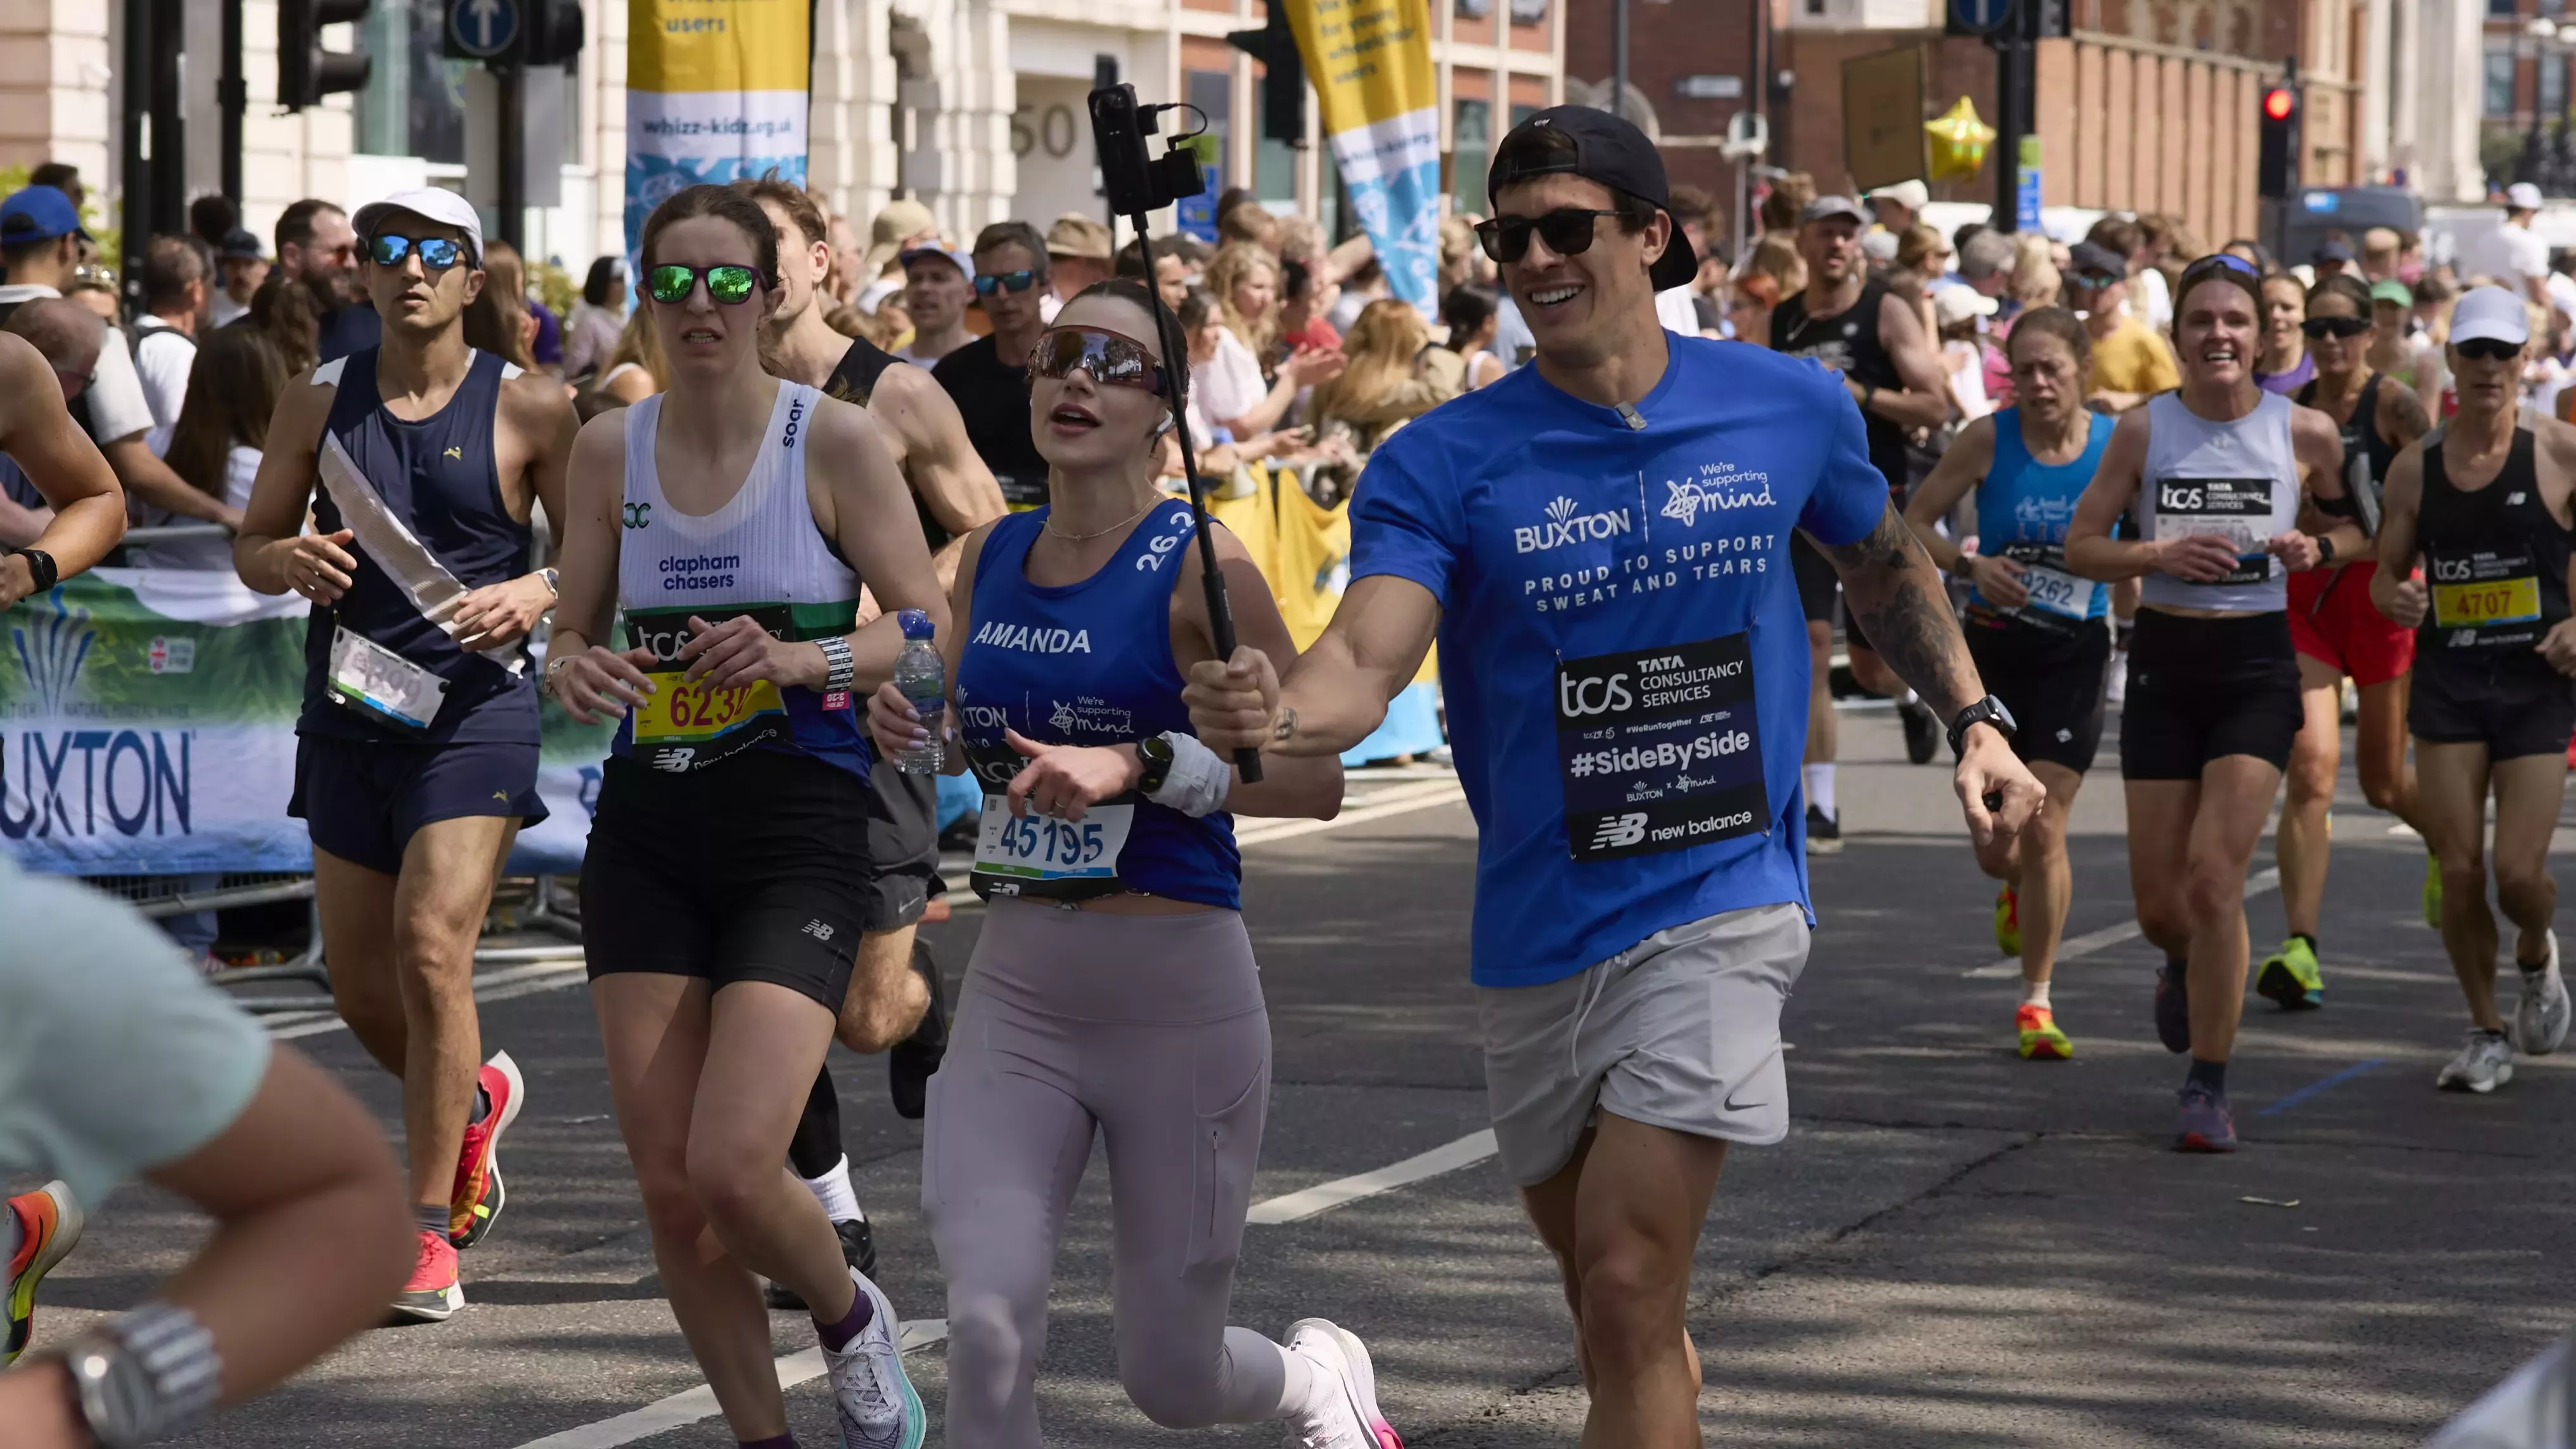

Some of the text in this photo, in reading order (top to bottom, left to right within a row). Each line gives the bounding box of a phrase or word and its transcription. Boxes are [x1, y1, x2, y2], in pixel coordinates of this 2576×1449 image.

[665, 17, 726, 32] users
[783, 399, 804, 449] soar
[1700, 461, 1735, 476] We're
[1701, 471, 1768, 487] supporting
[1701, 484, 1777, 513] mind
[2162, 483, 2204, 509] tcs
[1136, 511, 1195, 571] 26.2
[1514, 507, 1631, 554] BUXTON
[658, 554, 740, 575] clapham
[1525, 534, 1774, 596] PROUD TO SUPPORT
[2434, 556, 2471, 581] tcs
[663, 573, 735, 590] chasers
[1536, 557, 1767, 613] SWEAT AND TEARS
[2456, 590, 2513, 616] 4707
[973, 621, 1092, 653] AMANDA
[1637, 654, 1686, 673] TATA
[1639, 660, 1744, 691] CONSULTANCY
[1077, 696, 1105, 706] We're
[1561, 671, 1633, 717] tcs
[1642, 684, 1712, 708] SERVICES
[1077, 706, 1131, 718] supporting
[1076, 719, 1135, 734] mind
[1625, 718, 1693, 734] #WeRunTogether
[1570, 729, 1750, 778] #SideBySide
[1690, 775, 1717, 788] mind
[1626, 789, 1663, 803] BUXTON
[1651, 810, 1752, 842] new balance
[1000, 814, 1104, 866] 45195
